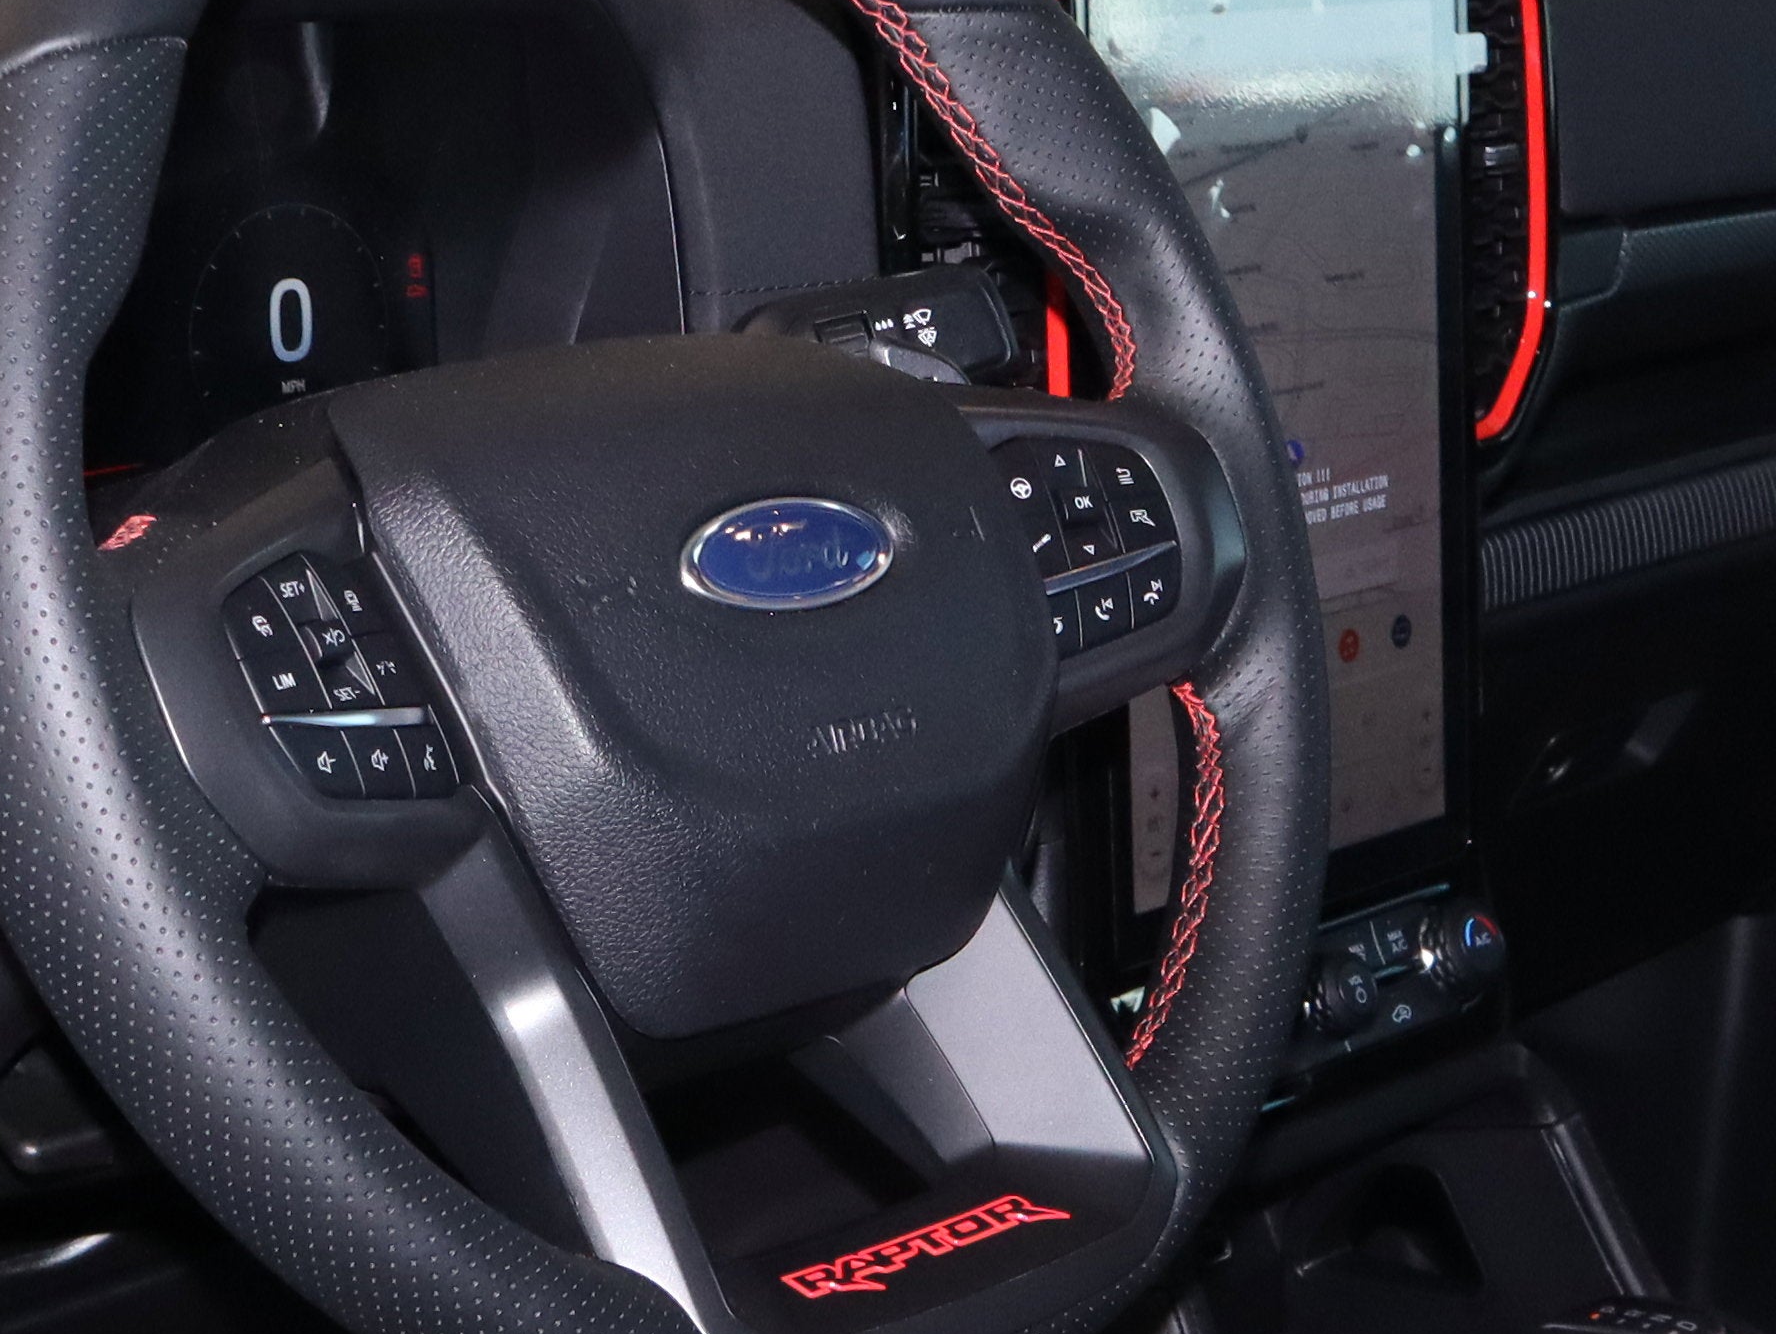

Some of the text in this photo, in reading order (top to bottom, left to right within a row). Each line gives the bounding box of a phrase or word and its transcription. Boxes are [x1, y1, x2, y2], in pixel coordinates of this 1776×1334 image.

[280, 379, 306, 394] MPH
[1296, 472, 1312, 487] ION
[1333, 474, 1388, 499] INSTALLATION
[1074, 495, 1093, 509] OK
[272, 672, 296, 691] LIM
[779, 1194, 1071, 1299] RAPTOR
